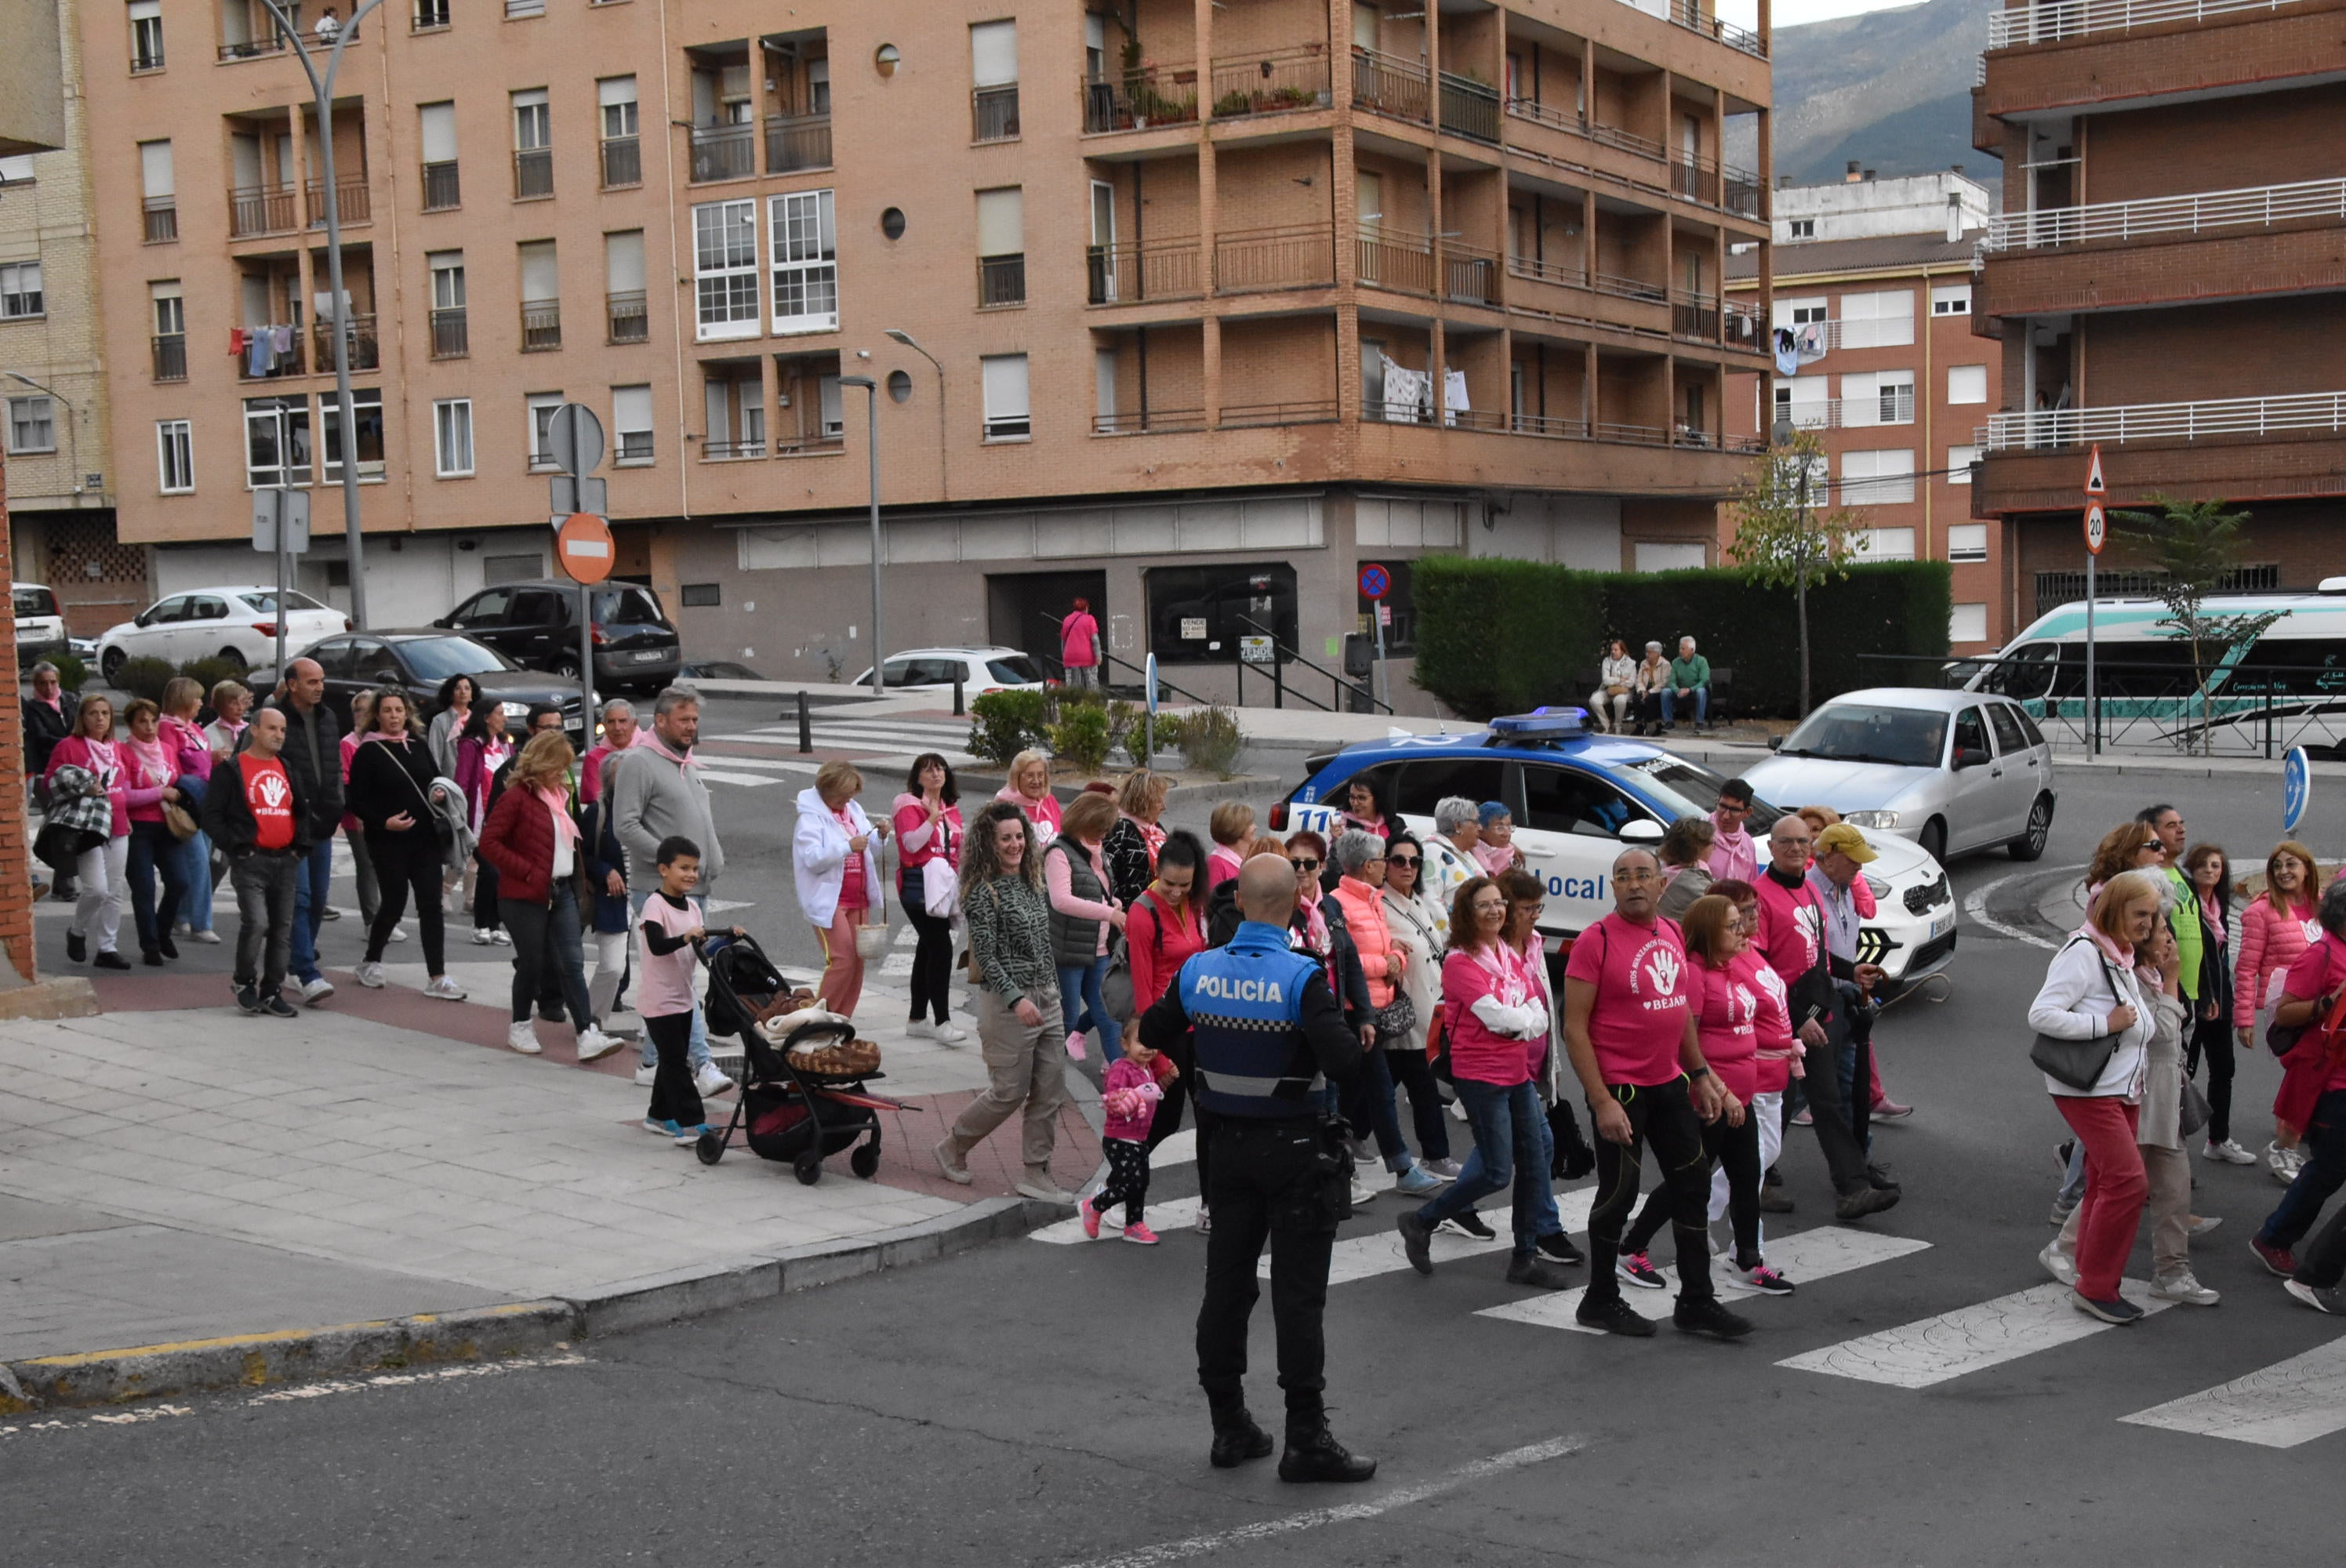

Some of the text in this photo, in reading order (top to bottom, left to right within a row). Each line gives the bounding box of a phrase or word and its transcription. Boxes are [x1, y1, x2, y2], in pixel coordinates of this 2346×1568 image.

[2090, 519, 2101, 535] 20
[1298, 809, 1340, 833] 11
[1196, 975, 1282, 1003] POLICÍA
